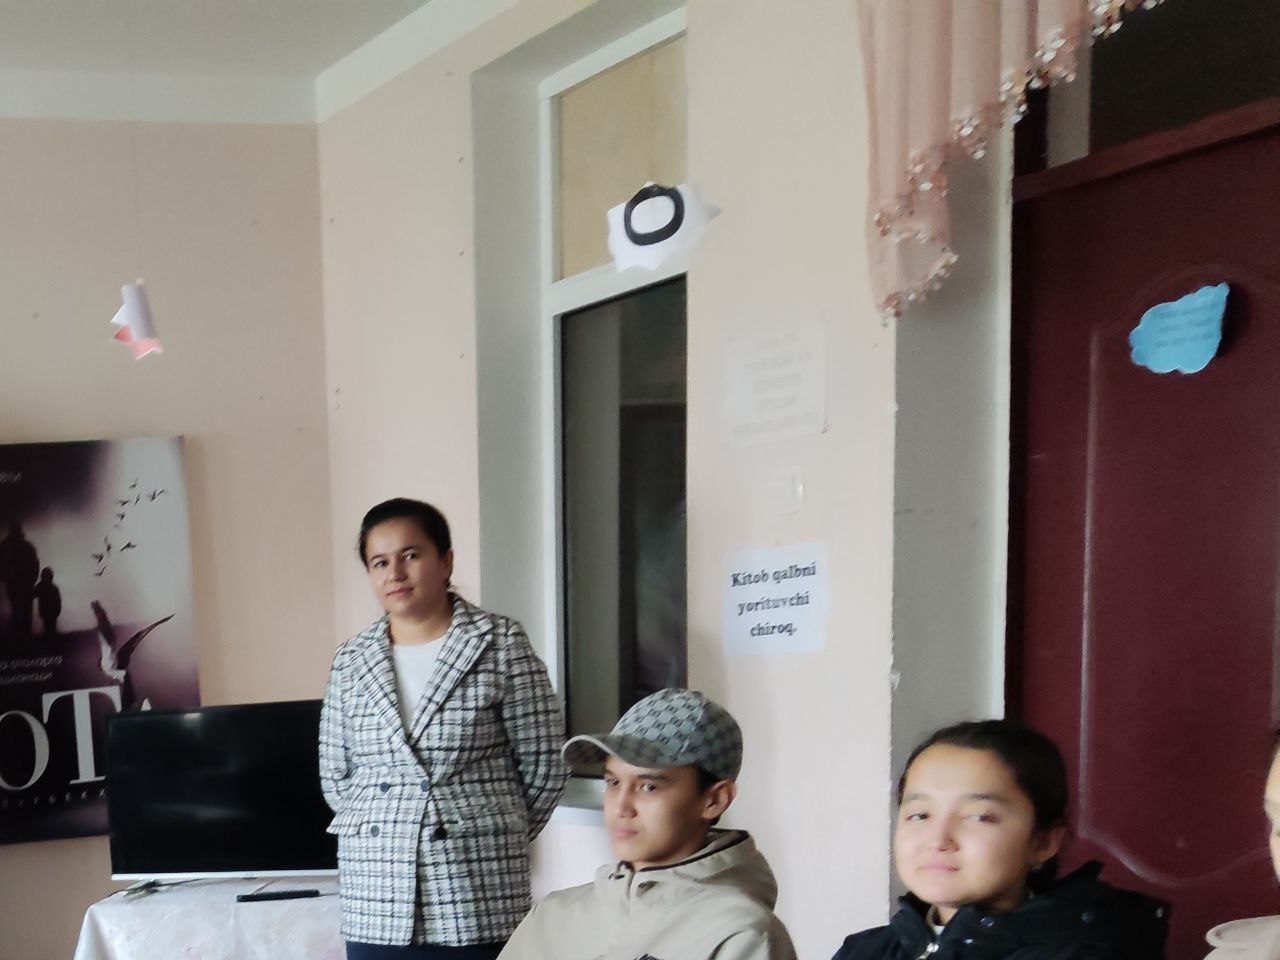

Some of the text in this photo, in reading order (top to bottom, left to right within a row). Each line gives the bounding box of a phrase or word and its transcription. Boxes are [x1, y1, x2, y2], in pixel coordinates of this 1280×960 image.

[731, 561, 816, 587] Kitob qalbni
[737, 590, 810, 616] yorituvchi
